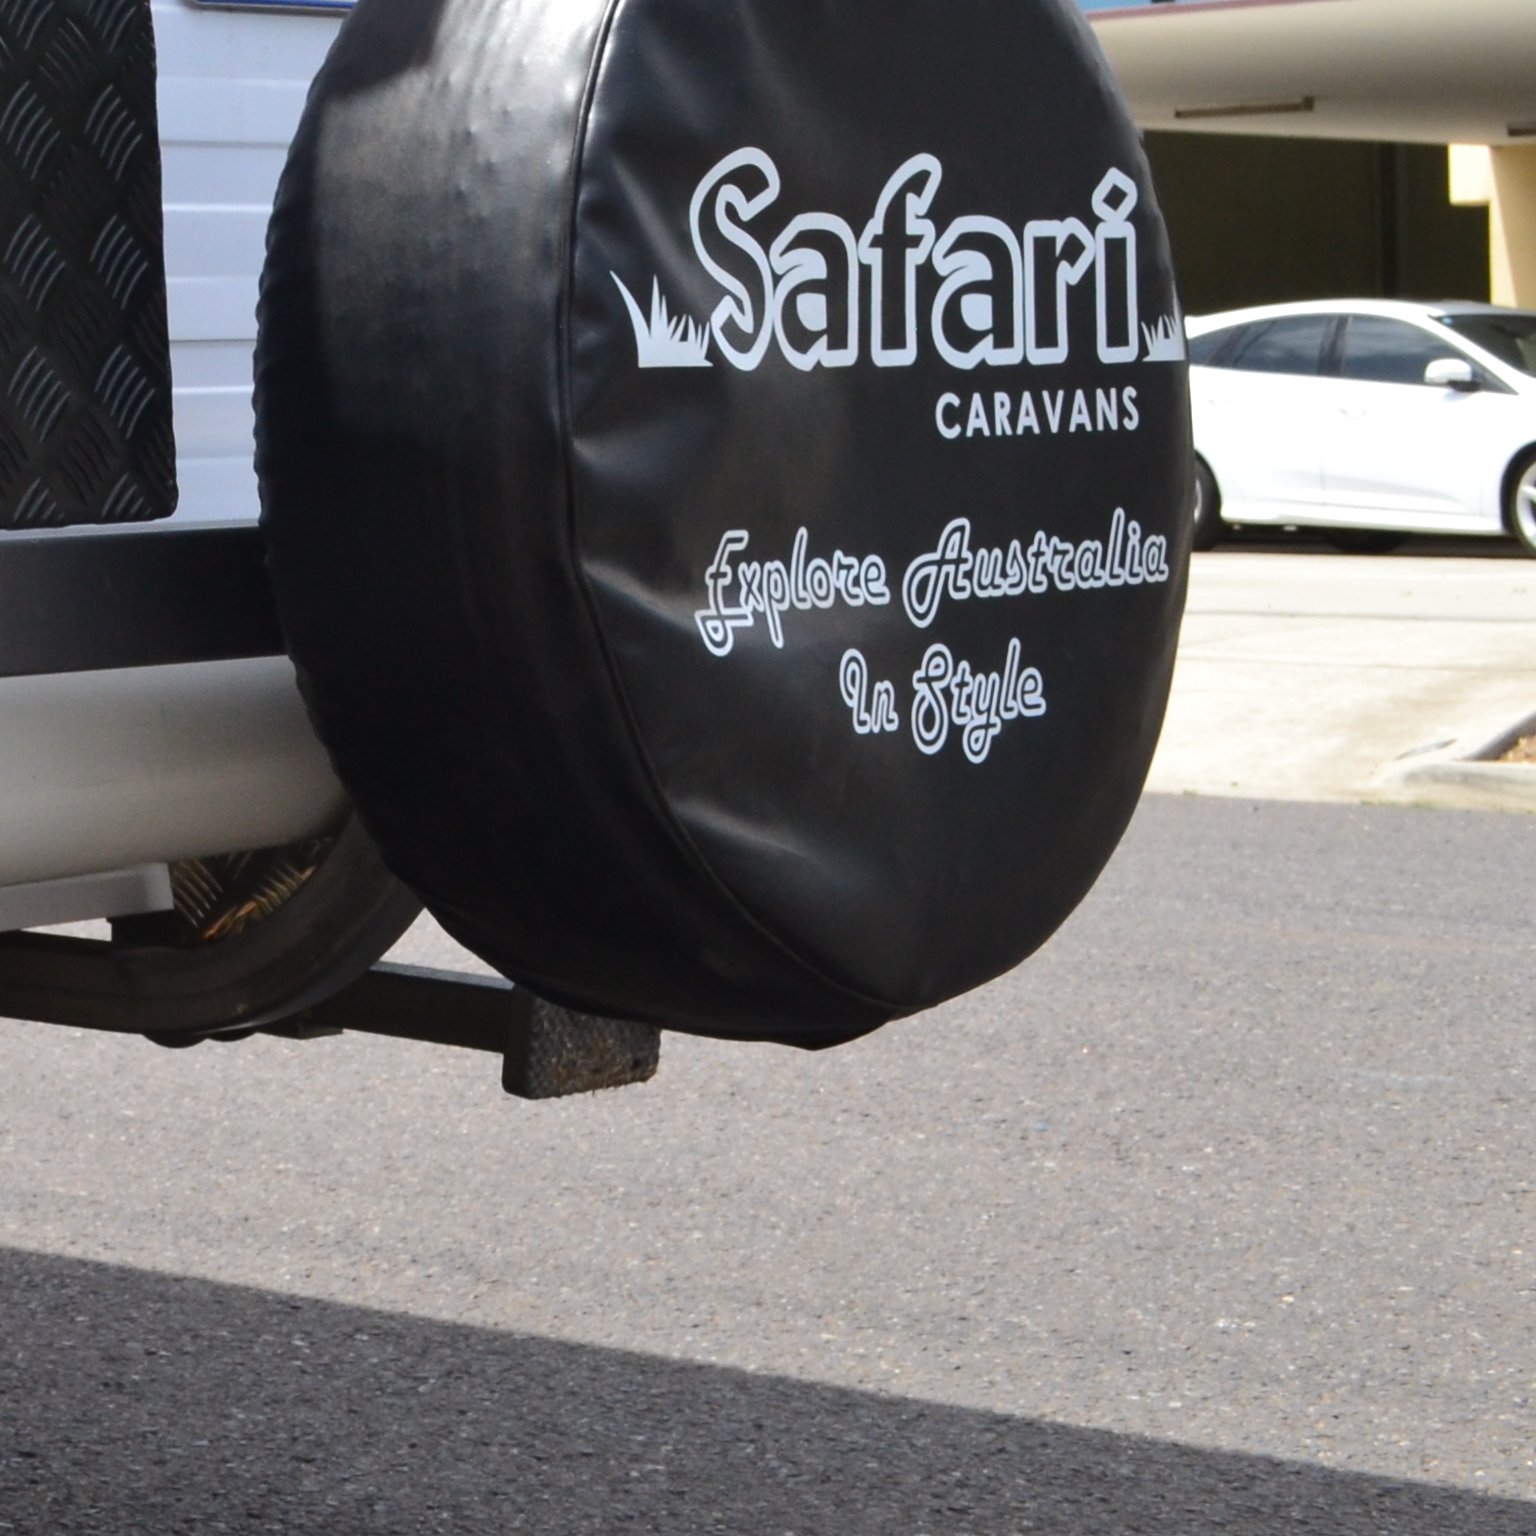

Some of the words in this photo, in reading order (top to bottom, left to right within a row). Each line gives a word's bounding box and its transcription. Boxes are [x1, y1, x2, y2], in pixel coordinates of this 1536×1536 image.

[688, 146, 1139, 372] Safari
[934, 386, 1140, 440] CARAVANS
[695, 526, 891, 657] Explore
[901, 507, 1170, 629] Australia
[839, 647, 899, 735] In
[911, 637, 1047, 764] Style
